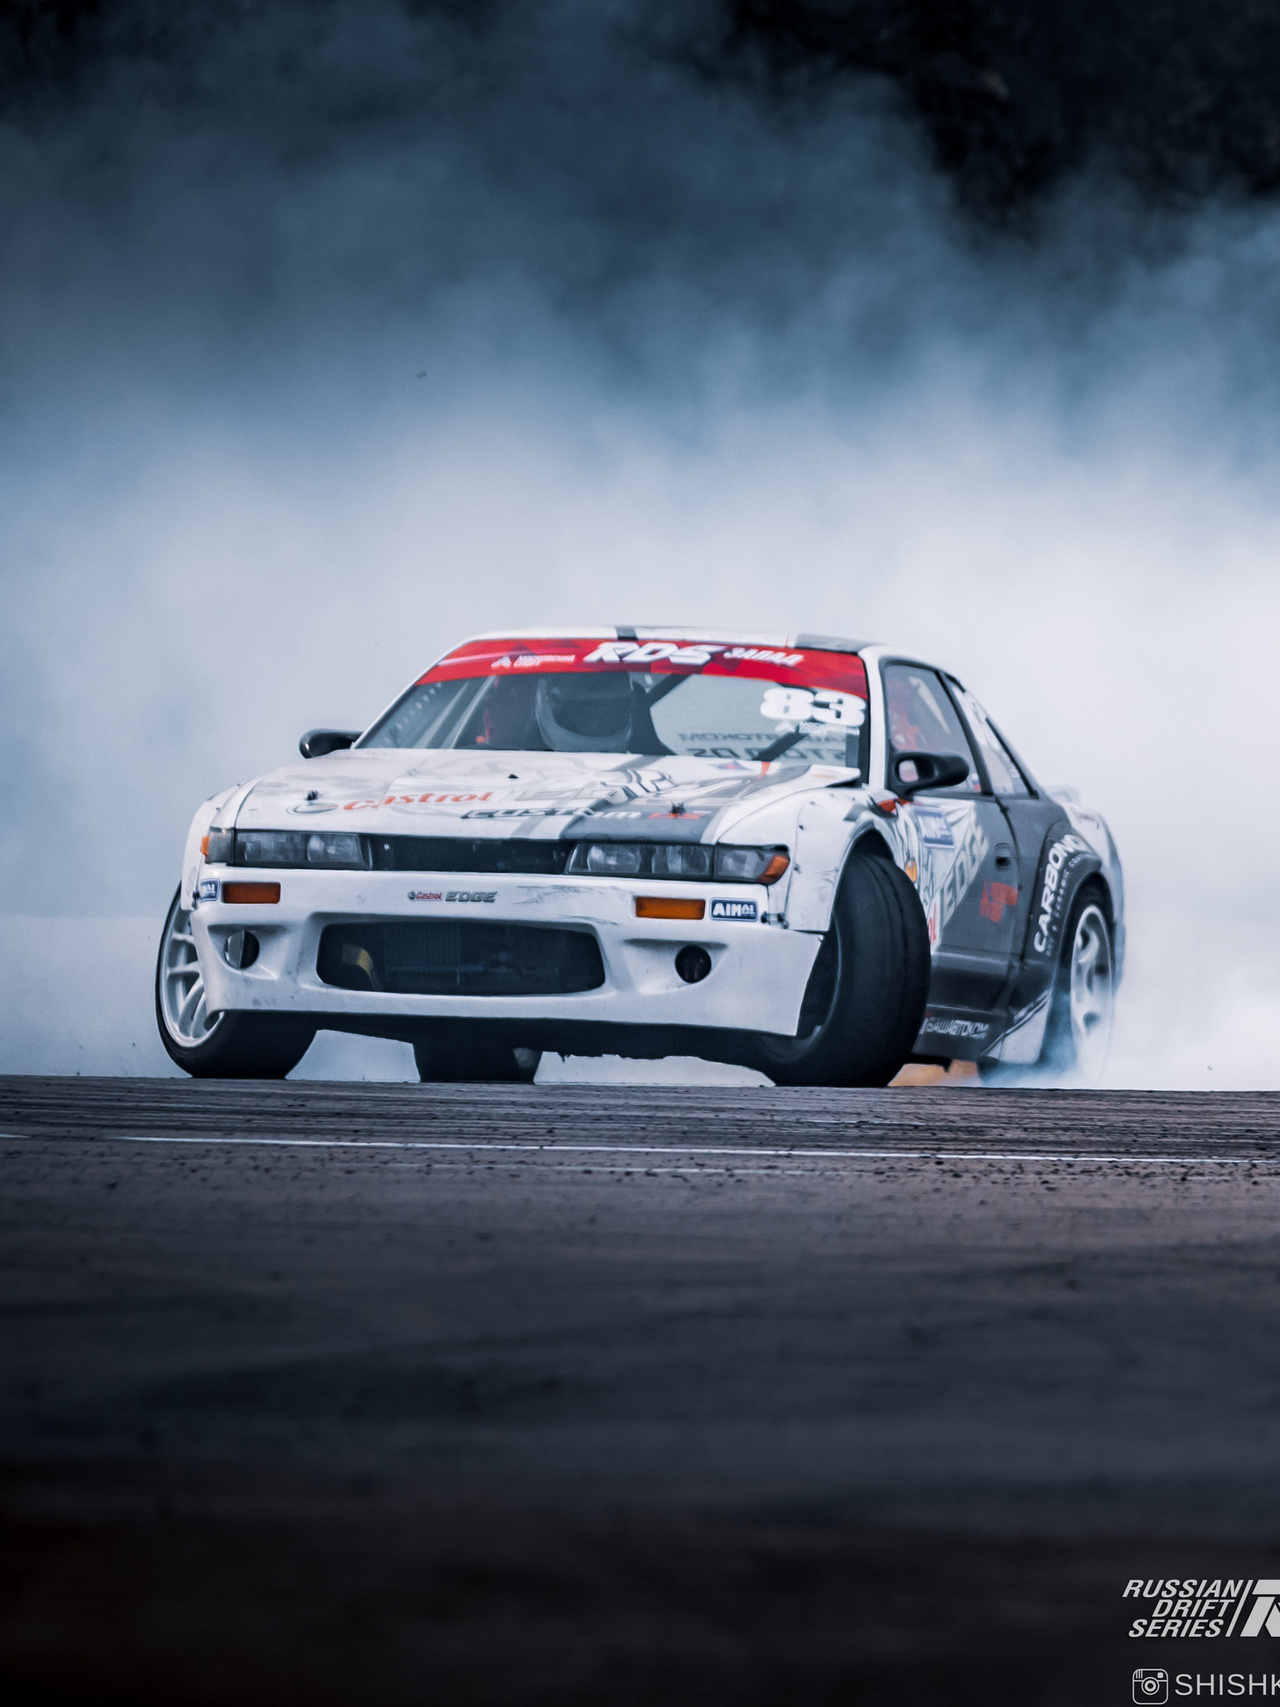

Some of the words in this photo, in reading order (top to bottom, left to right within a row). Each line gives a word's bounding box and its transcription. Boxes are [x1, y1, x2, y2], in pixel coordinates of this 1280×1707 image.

[583, 641, 729, 666] RDS
[723, 647, 805, 667] ЗАПАД
[760, 687, 867, 727] 83
[343, 791, 495, 811] Castrol
[416, 891, 442, 900] Castrol
[445, 891, 498, 903] EDGE
[712, 902, 755, 917] AIMOL
